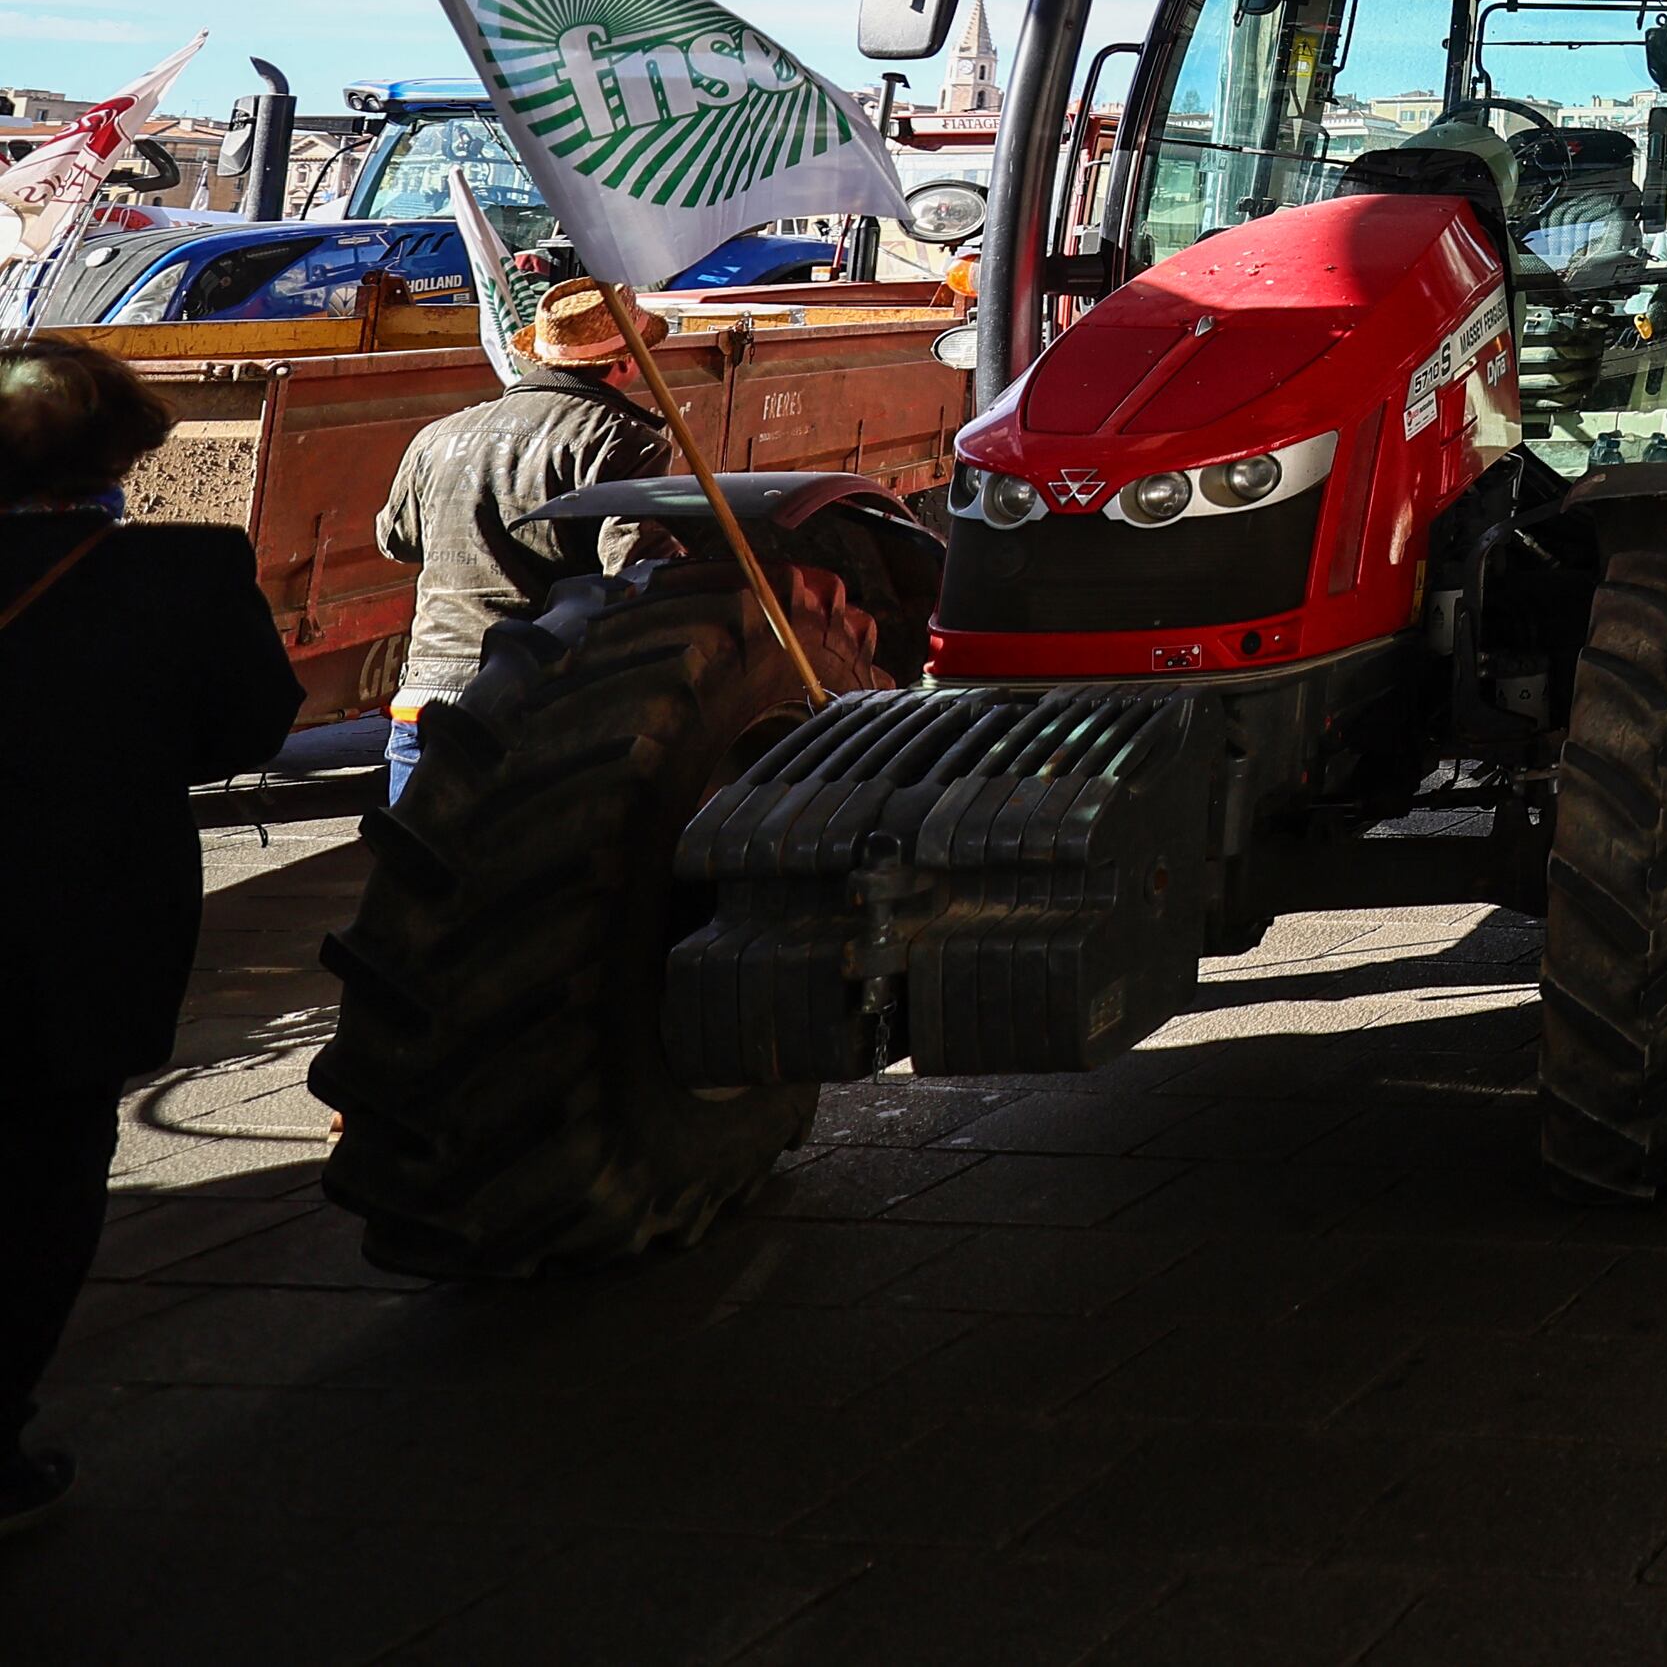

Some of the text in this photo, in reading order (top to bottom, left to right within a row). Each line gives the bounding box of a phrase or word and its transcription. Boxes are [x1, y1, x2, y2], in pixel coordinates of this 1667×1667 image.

[557, 22, 808, 141] fnse
[406, 274, 463, 293] HOLLAND
[1414, 361, 1440, 395] 5710
[1459, 312, 1485, 357] MASSEY
